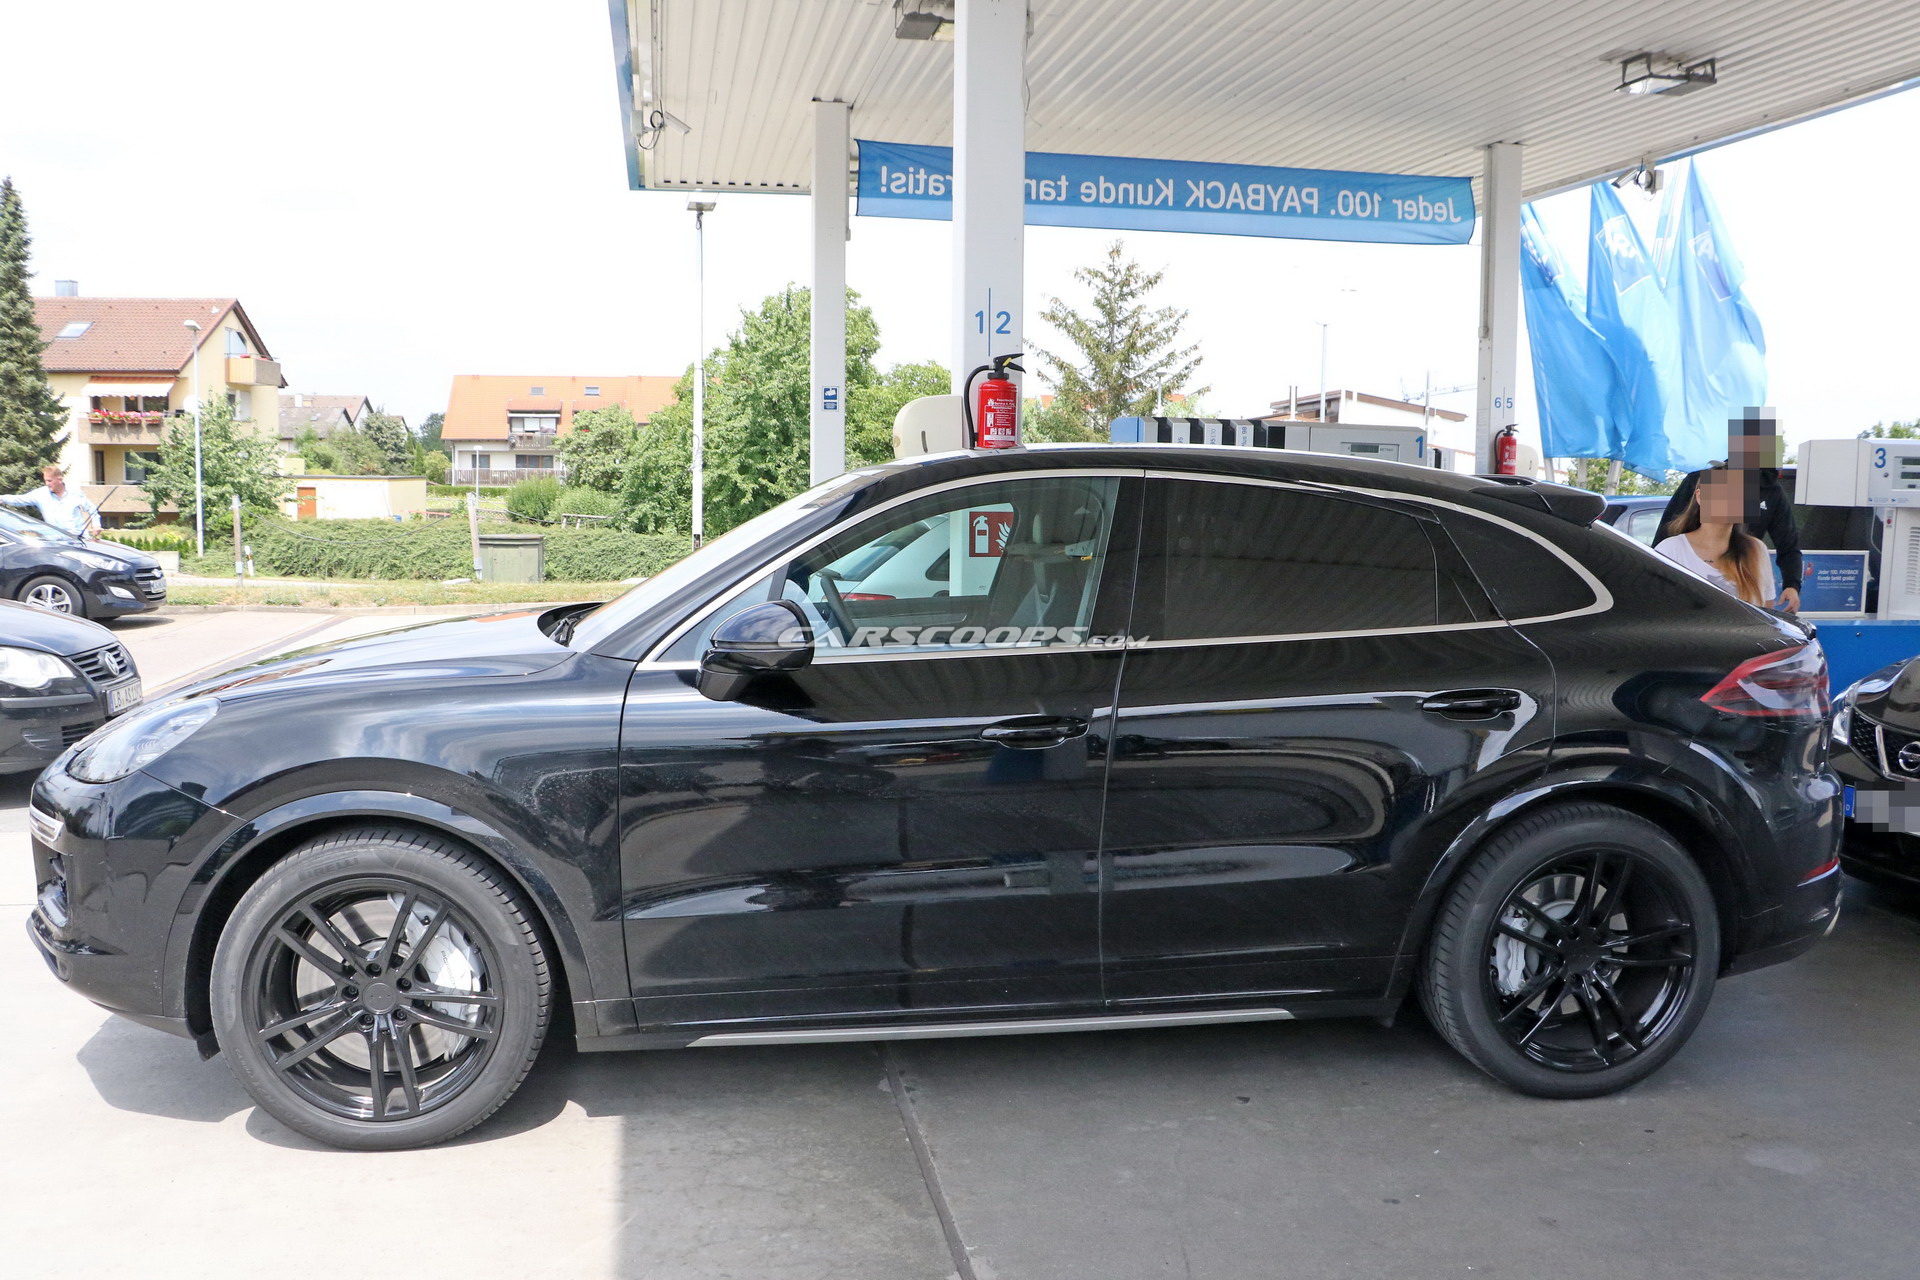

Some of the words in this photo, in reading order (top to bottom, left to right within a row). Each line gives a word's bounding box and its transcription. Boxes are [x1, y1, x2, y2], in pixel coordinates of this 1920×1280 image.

[975, 310, 984, 334] 1
[996, 311, 1011, 334] 2
[1494, 397, 1502, 409] 6
[1506, 397, 1513, 409] 5
[1242, 426, 1248, 435] 98
[1416, 435, 1424, 458] 1
[1874, 447, 1887, 469] 3
